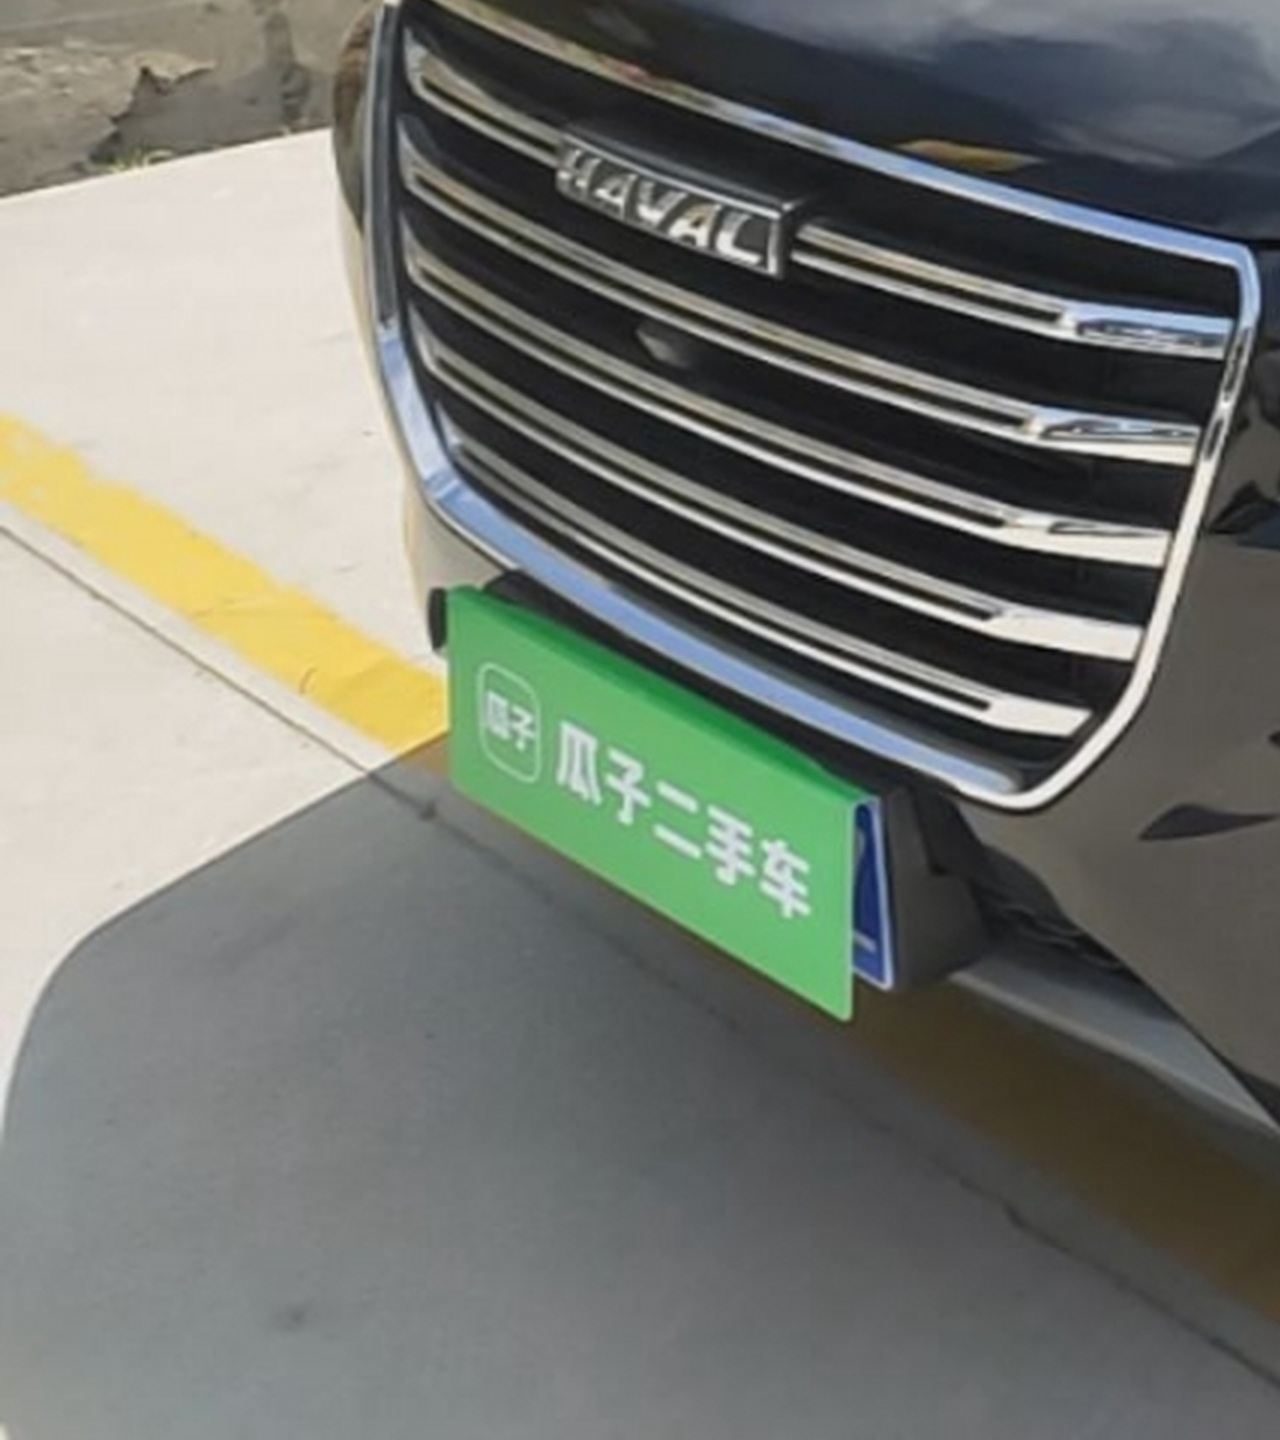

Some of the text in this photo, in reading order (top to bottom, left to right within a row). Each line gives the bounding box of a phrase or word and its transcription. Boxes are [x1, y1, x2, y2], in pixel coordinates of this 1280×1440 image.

[557, 139, 762, 266] HAVAL
[484, 689, 537, 752] 瓜子
[555, 720, 812, 919] 瓜子二手车
